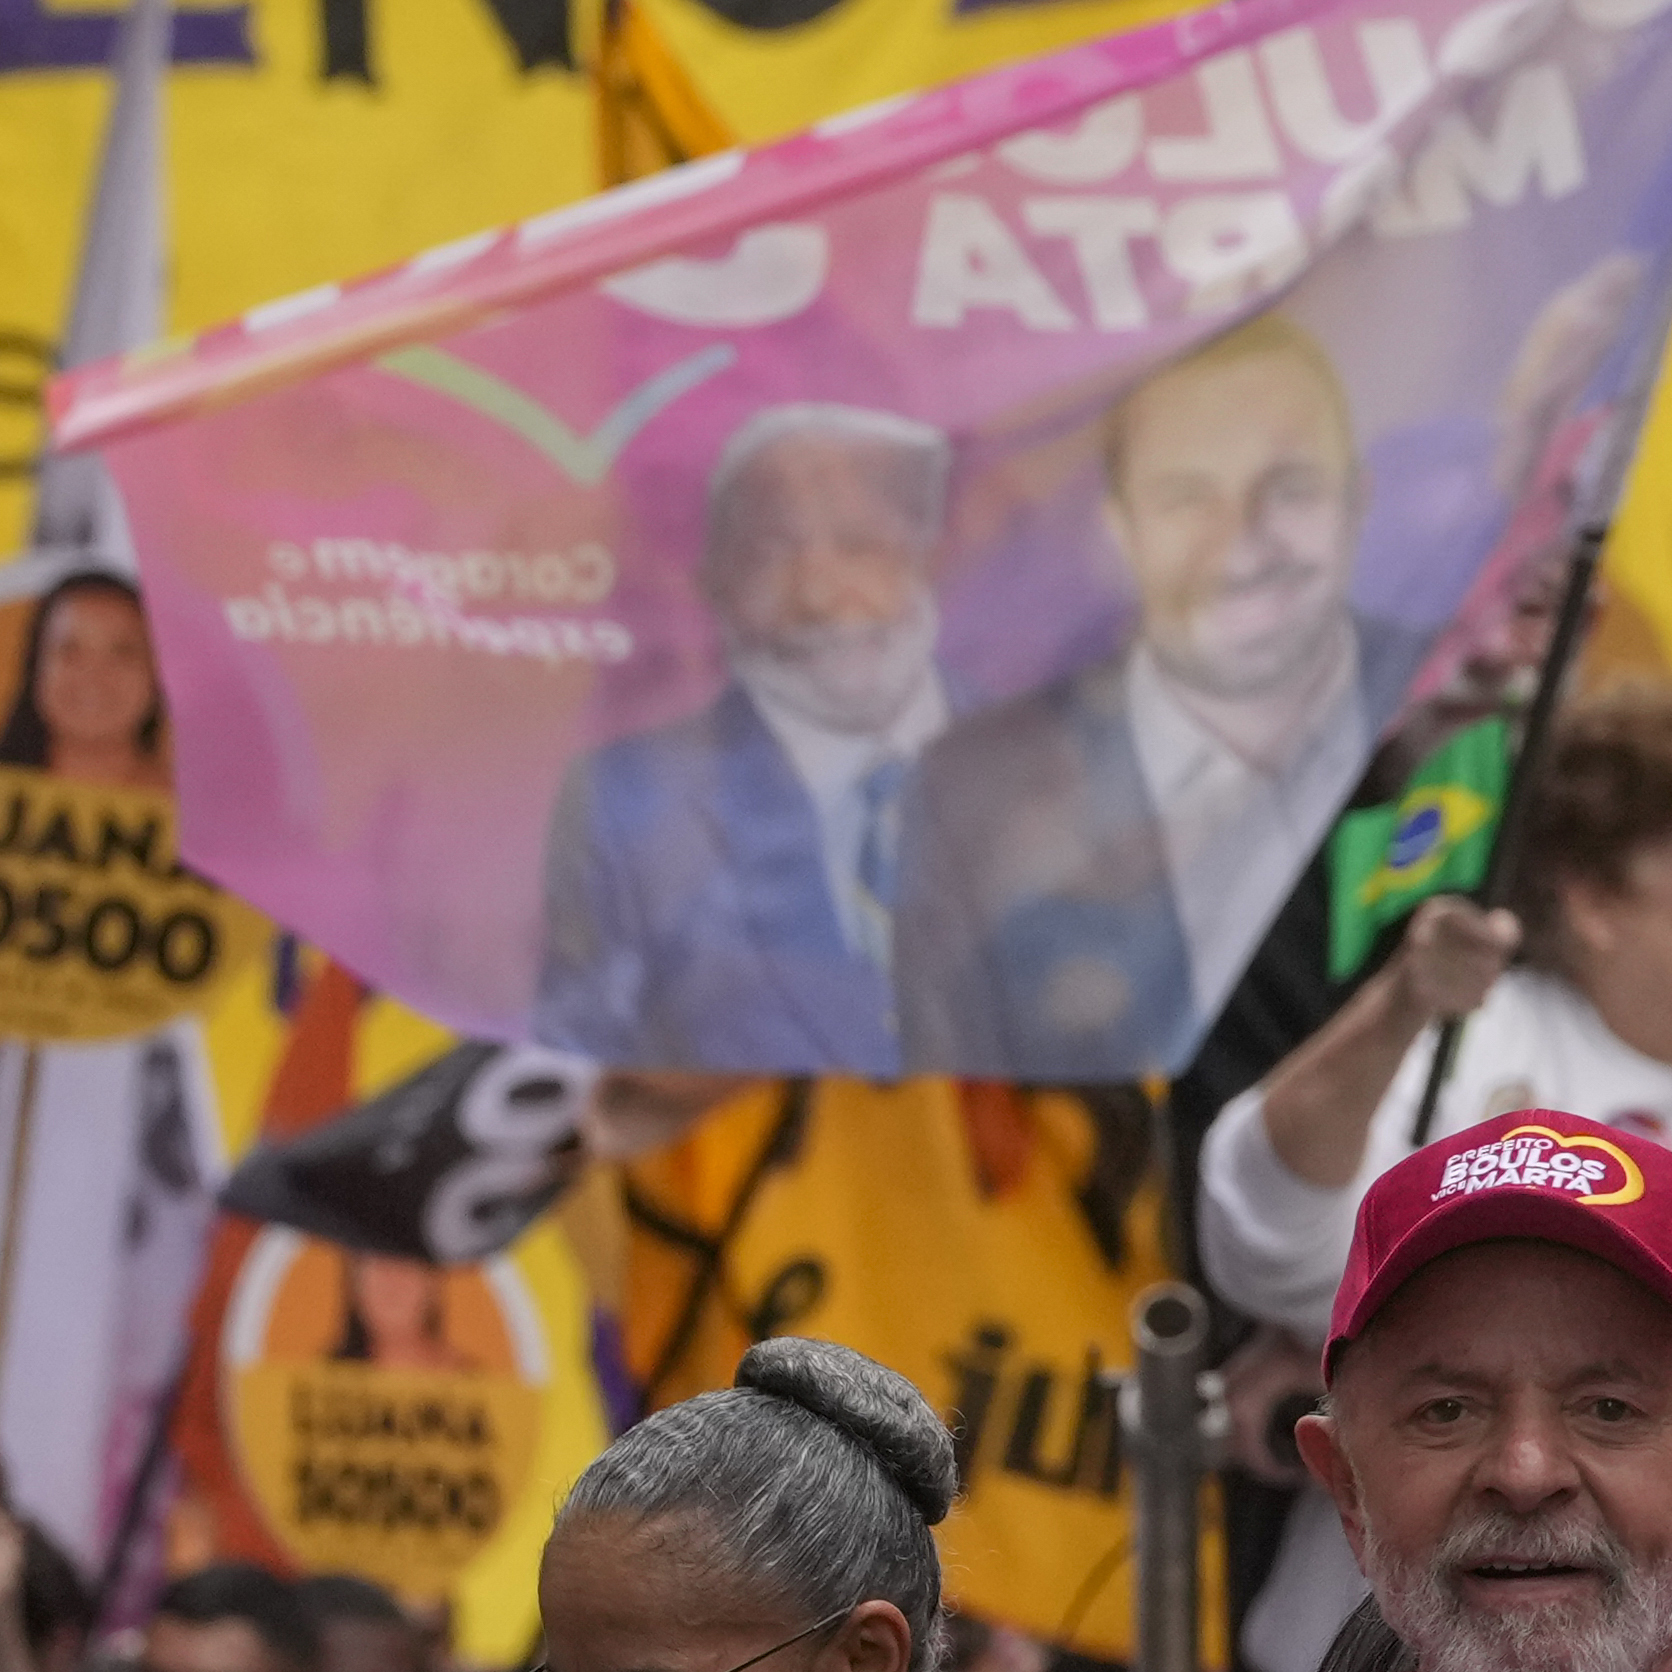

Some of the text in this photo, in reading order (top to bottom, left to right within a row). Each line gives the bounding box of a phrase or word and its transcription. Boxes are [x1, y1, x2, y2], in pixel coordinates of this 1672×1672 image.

[0, 880, 215, 982] 500
[1440, 1147, 1607, 1188] BOULOS
[1446, 1137, 1554, 1166] PREFEITO
[1431, 1167, 1595, 1202] VICE MARTA
